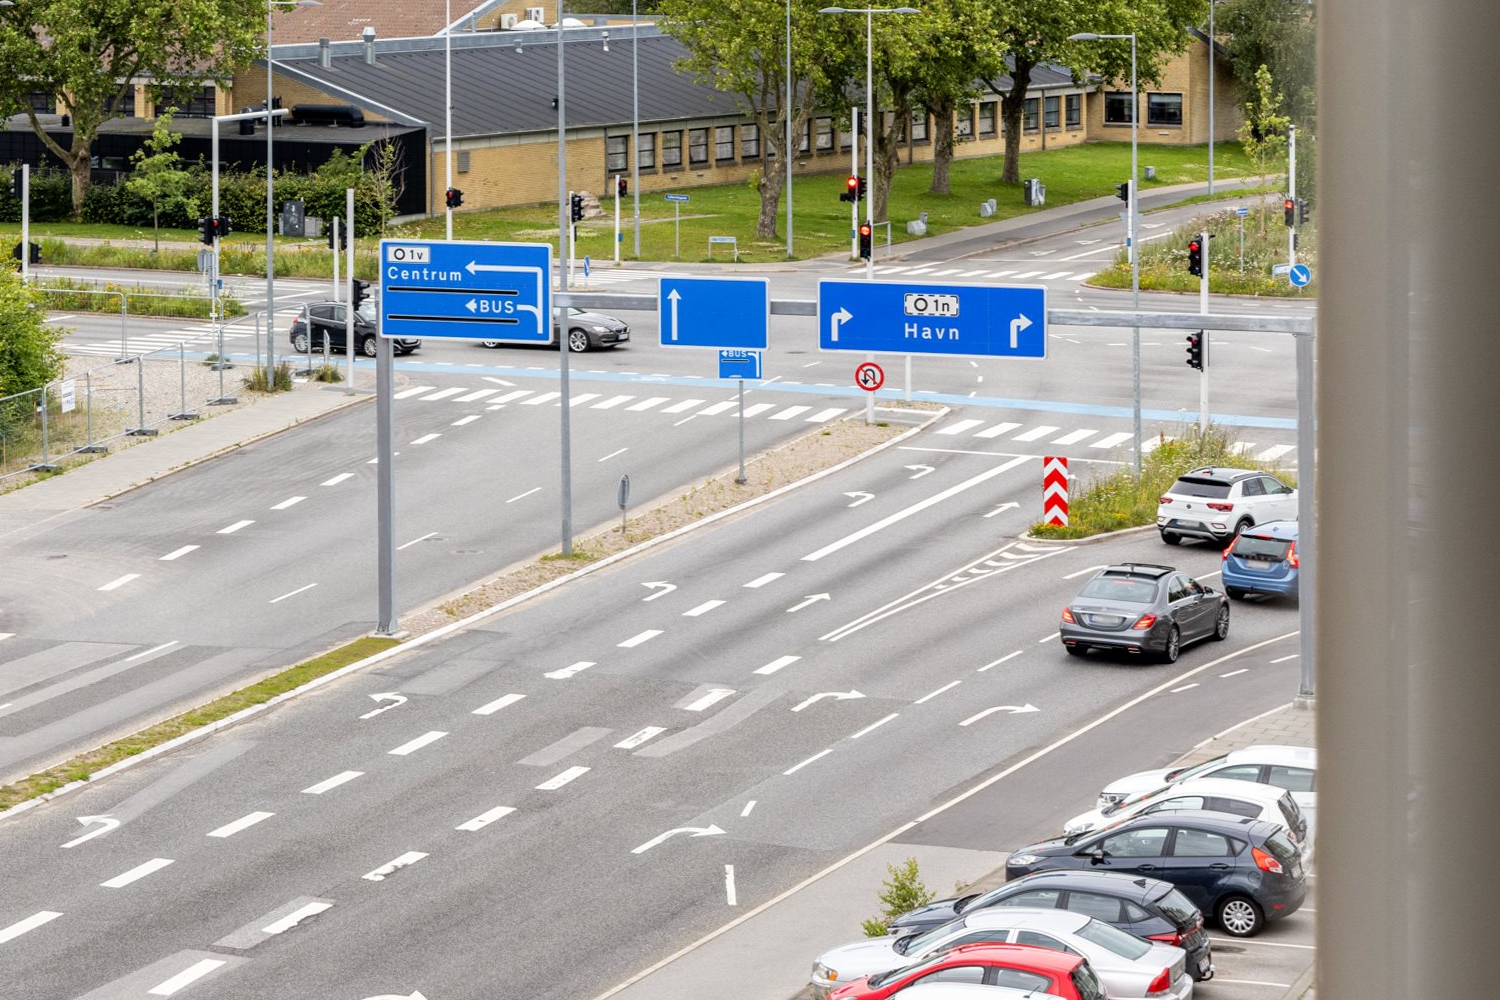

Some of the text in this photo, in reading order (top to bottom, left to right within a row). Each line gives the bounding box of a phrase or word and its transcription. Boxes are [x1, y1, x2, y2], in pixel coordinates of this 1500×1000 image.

[387, 266, 461, 281] Centrum
[480, 300, 514, 313] BUS
[904, 322, 959, 340] Havn
[728, 350, 747, 358] BUS
